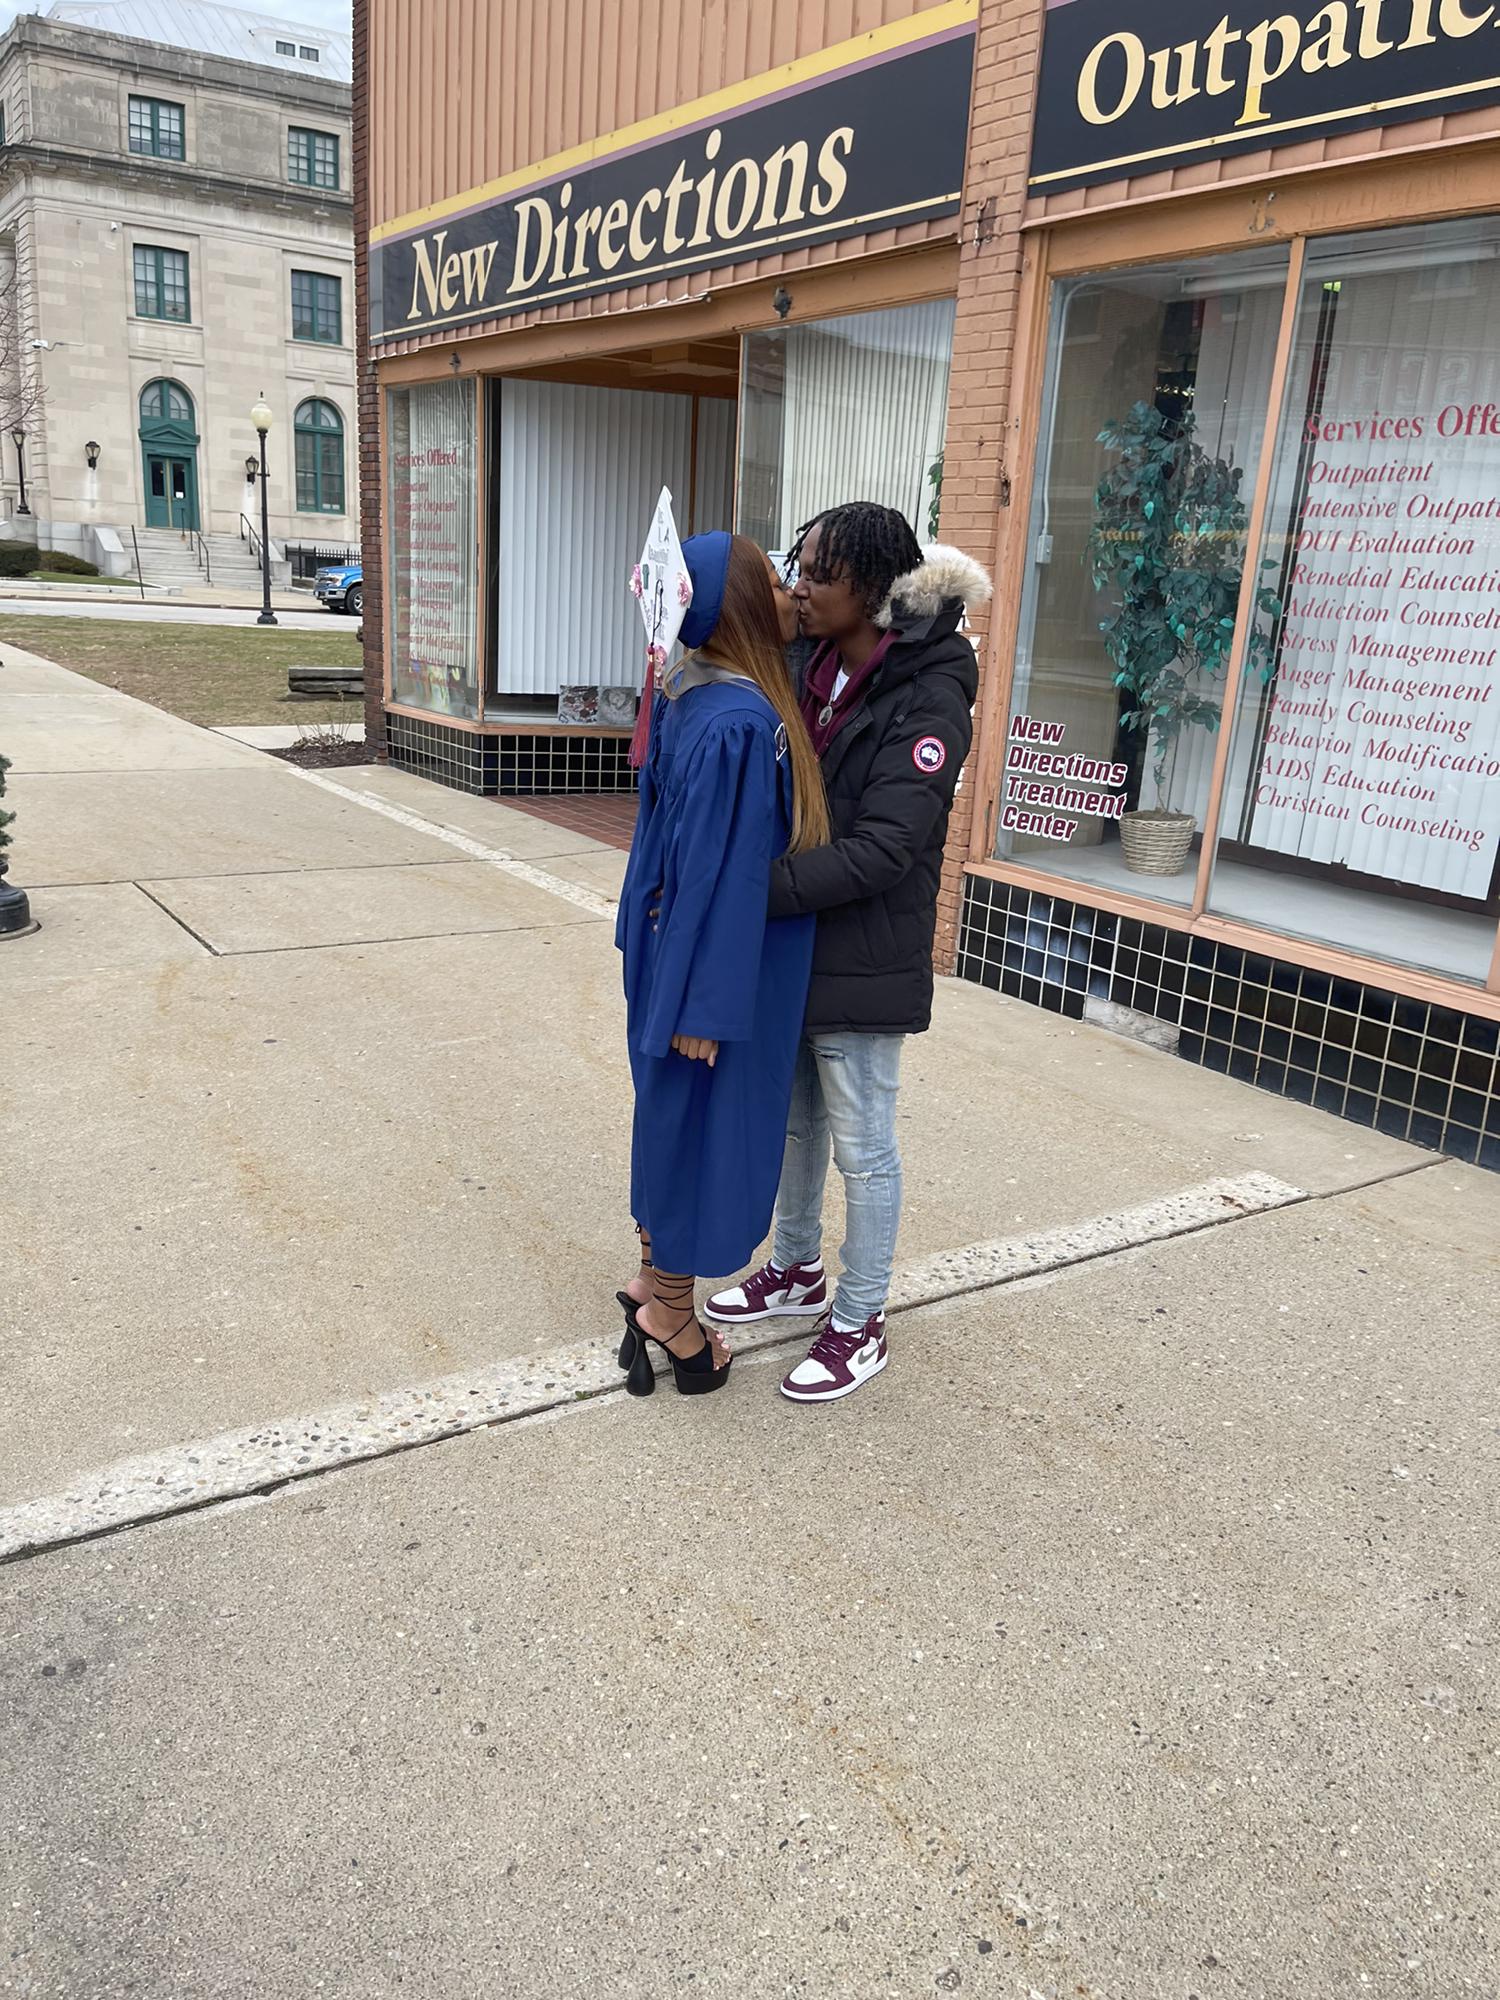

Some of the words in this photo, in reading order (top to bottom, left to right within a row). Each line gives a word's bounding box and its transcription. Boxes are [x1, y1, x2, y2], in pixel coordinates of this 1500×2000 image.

[1076, 0, 1500, 126] Outpati
[406, 230, 499, 320] New
[506, 127, 856, 295] Directions
[1303, 409, 1425, 445] Services
[1436, 403, 1500, 437] Offe
[1308, 459, 1434, 489] Outpatient
[1299, 494, 1397, 519] Intensive
[1294, 529, 1343, 553] DUI
[1347, 529, 1475, 556] Evaluation
[1288, 563, 1394, 588] Remedial
[1399, 565, 1500, 593] Educati
[1283, 597, 1389, 623] Addiction
[1278, 627, 1337, 653] Stress
[1345, 633, 1497, 668] Management
[1272, 661, 1336, 690] Anger
[1342, 667, 1493, 703] Management
[1008, 715, 1065, 746] New
[1267, 692, 1338, 724] Family
[1347, 700, 1472, 743] Counseling
[1005, 745, 1128, 788] Directions
[1263, 723, 1353, 755] Behavior
[1361, 738, 1500, 777] Modificatio
[1005, 774, 1128, 820] Treatment
[1257, 755, 1315, 782] AIDS
[1322, 764, 1436, 802] Education
[1001, 805, 1079, 842] Center
[1254, 784, 1351, 821] Christian
[1360, 803, 1485, 852] Counseling
